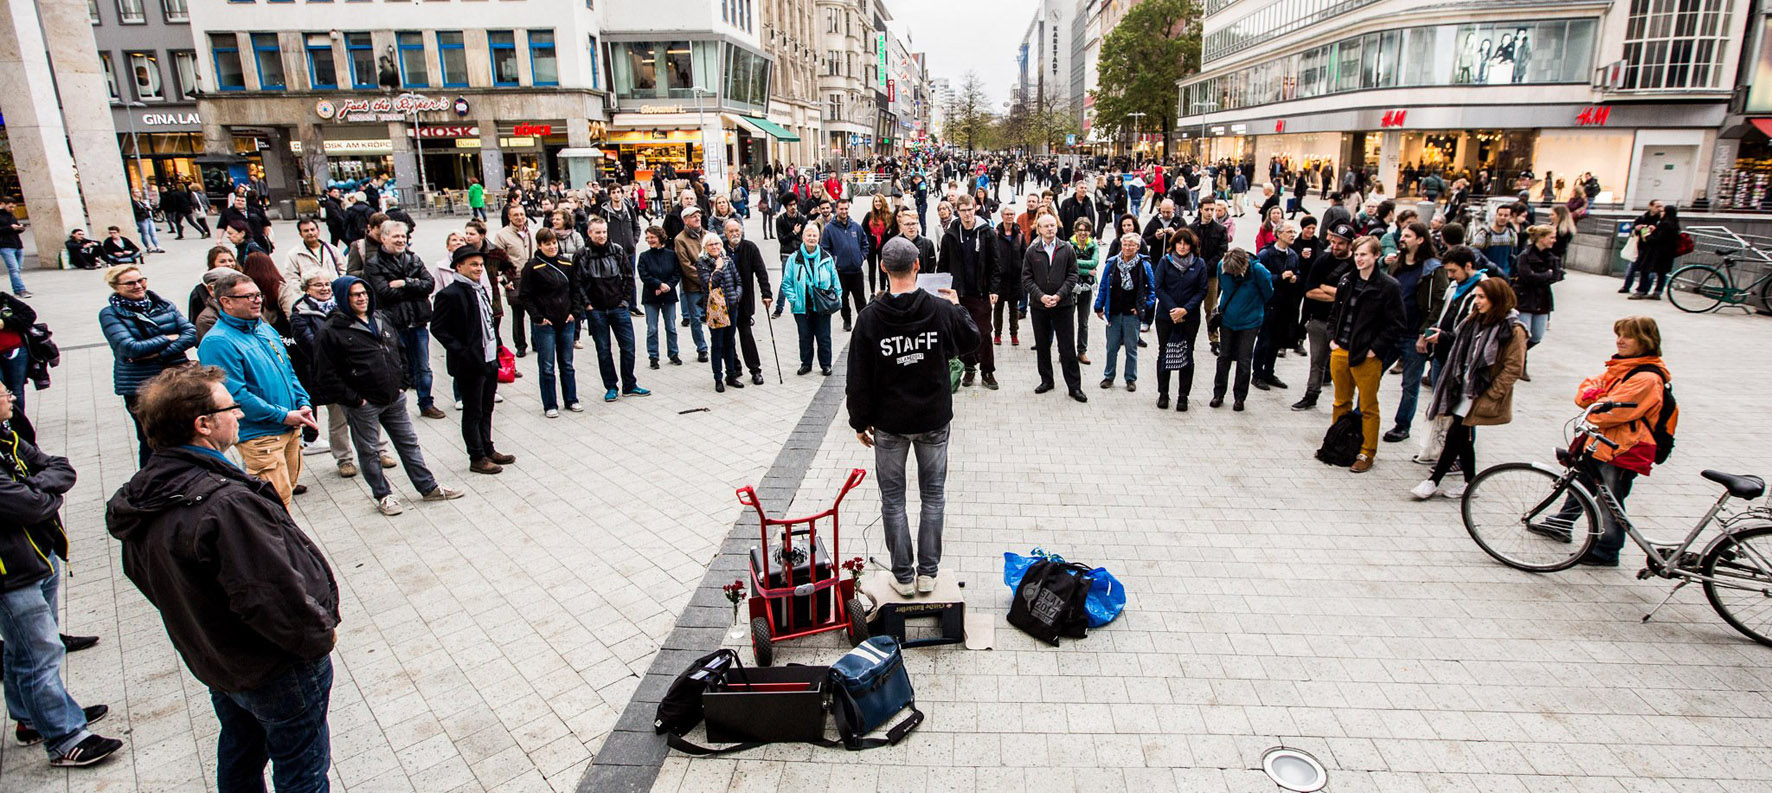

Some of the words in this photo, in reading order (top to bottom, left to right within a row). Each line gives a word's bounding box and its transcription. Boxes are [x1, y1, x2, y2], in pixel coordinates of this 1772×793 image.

[337, 98, 370, 120] Jack
[372, 98, 391, 113] the
[1575, 106, 1611, 126] H&M
[142, 113, 179, 125] GINA
[1379, 110, 1407, 128] H&M
[413, 126, 473, 138] KIOSK
[513, 122, 552, 136] DÖNER
[346, 141, 359, 149] AM
[361, 140, 392, 149] KRÖPC
[880, 331, 938, 357] STAFF
[1035, 600, 1057, 616] 2017
